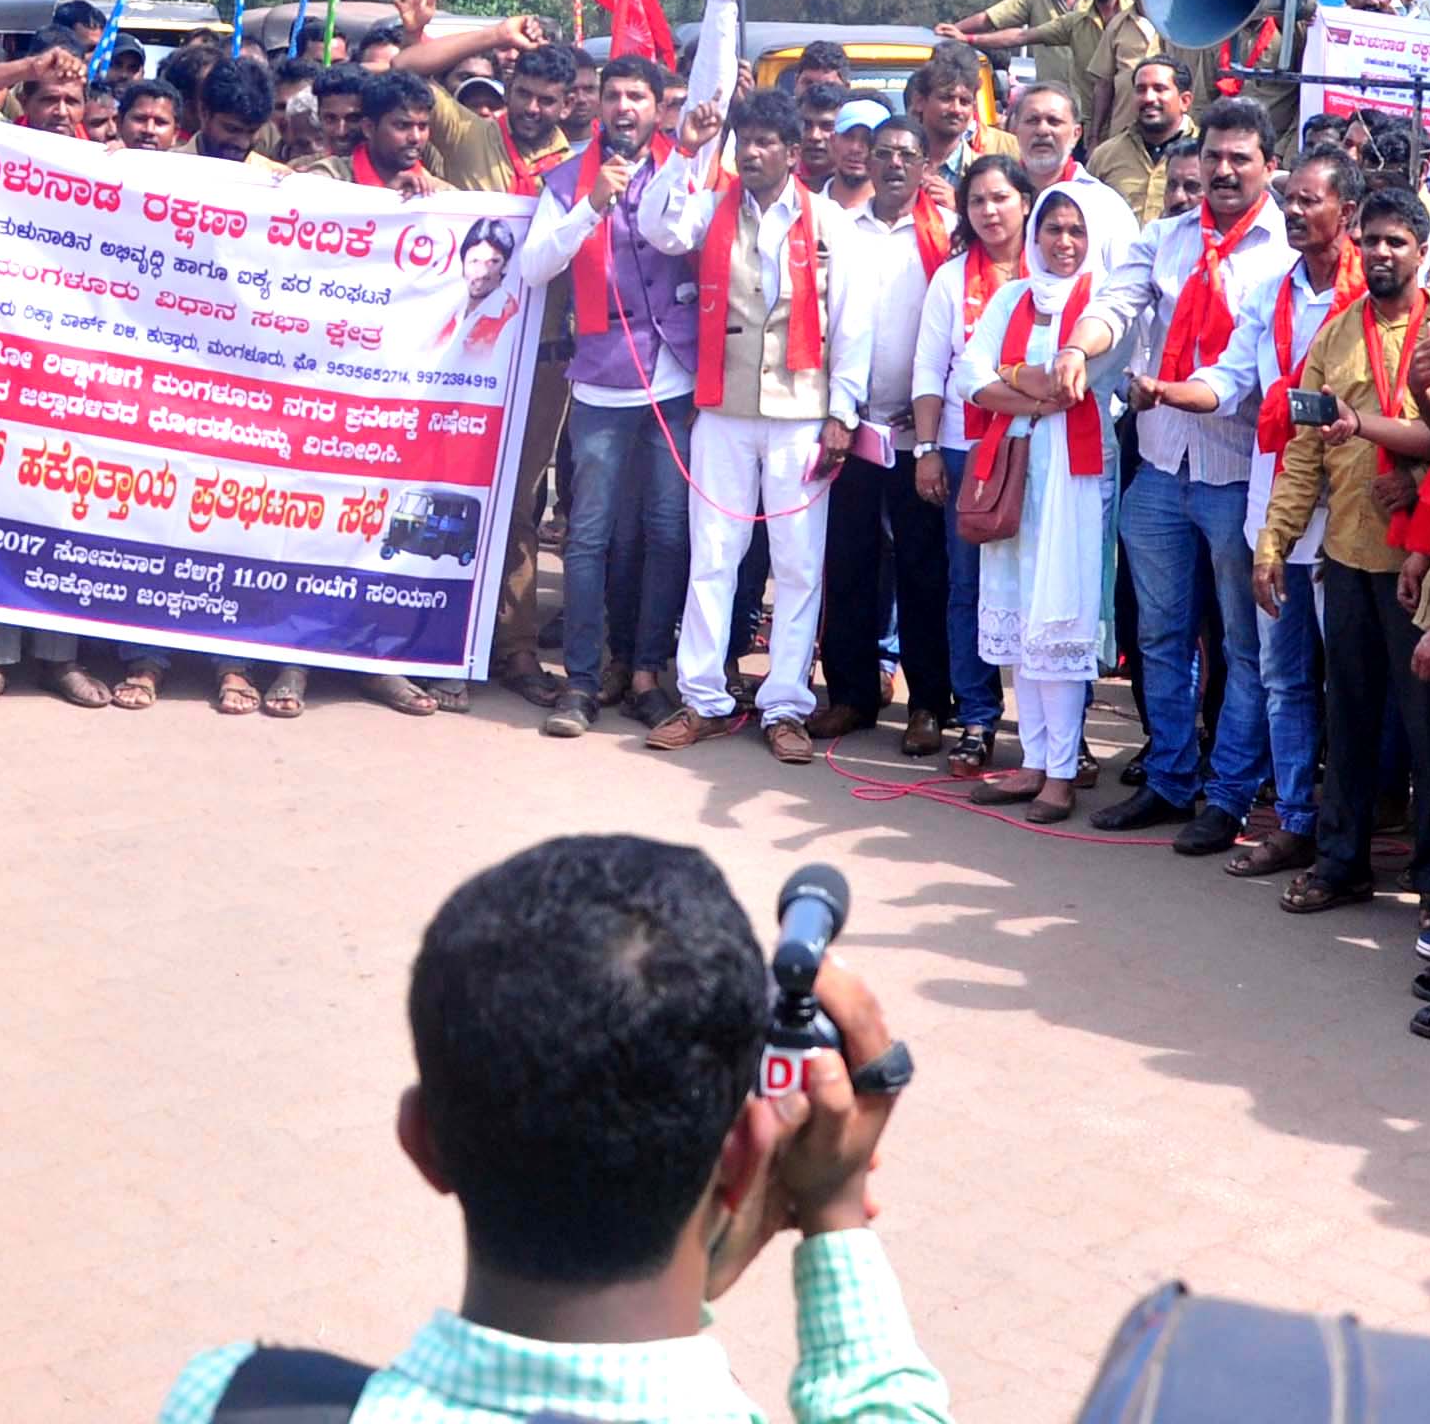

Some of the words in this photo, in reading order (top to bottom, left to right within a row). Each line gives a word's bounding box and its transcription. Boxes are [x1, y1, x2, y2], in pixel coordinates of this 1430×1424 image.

[143, 192, 248, 248] ರಕ್ಷಣಾ
[267, 209, 376, 258] ವೇದಿಕೆ
[173, 255, 228, 281] ಹಾಗೂ
[237, 269, 272, 299] ಐಕ್ಯ
[281, 274, 312, 293] ಪರ
[319, 281, 392, 305] ಸಂಘಟನೆ
[155, 289, 236, 321] ವಿಧಾನ
[251, 309, 310, 334] ಸಭಾ
[325, 319, 384, 351] ಕ್ಷೇತ್ರ
[152, 372, 273, 411] ಮಂಗಳೂರು
[282, 395, 337, 422] ನಗರ
[188, 466, 325, 533] ಪ್ರತಿಭಟನಾ
[337, 486, 390, 543] ಸಭೆ
[53, 540, 167, 575] ಸೋಮವಾರ
[232, 567, 288, 591] 11.00
[295, 576, 358, 600] ಗಂಟೆಗೆ
[366, 582, 447, 609] ಸರಿಯಾಗಿ
